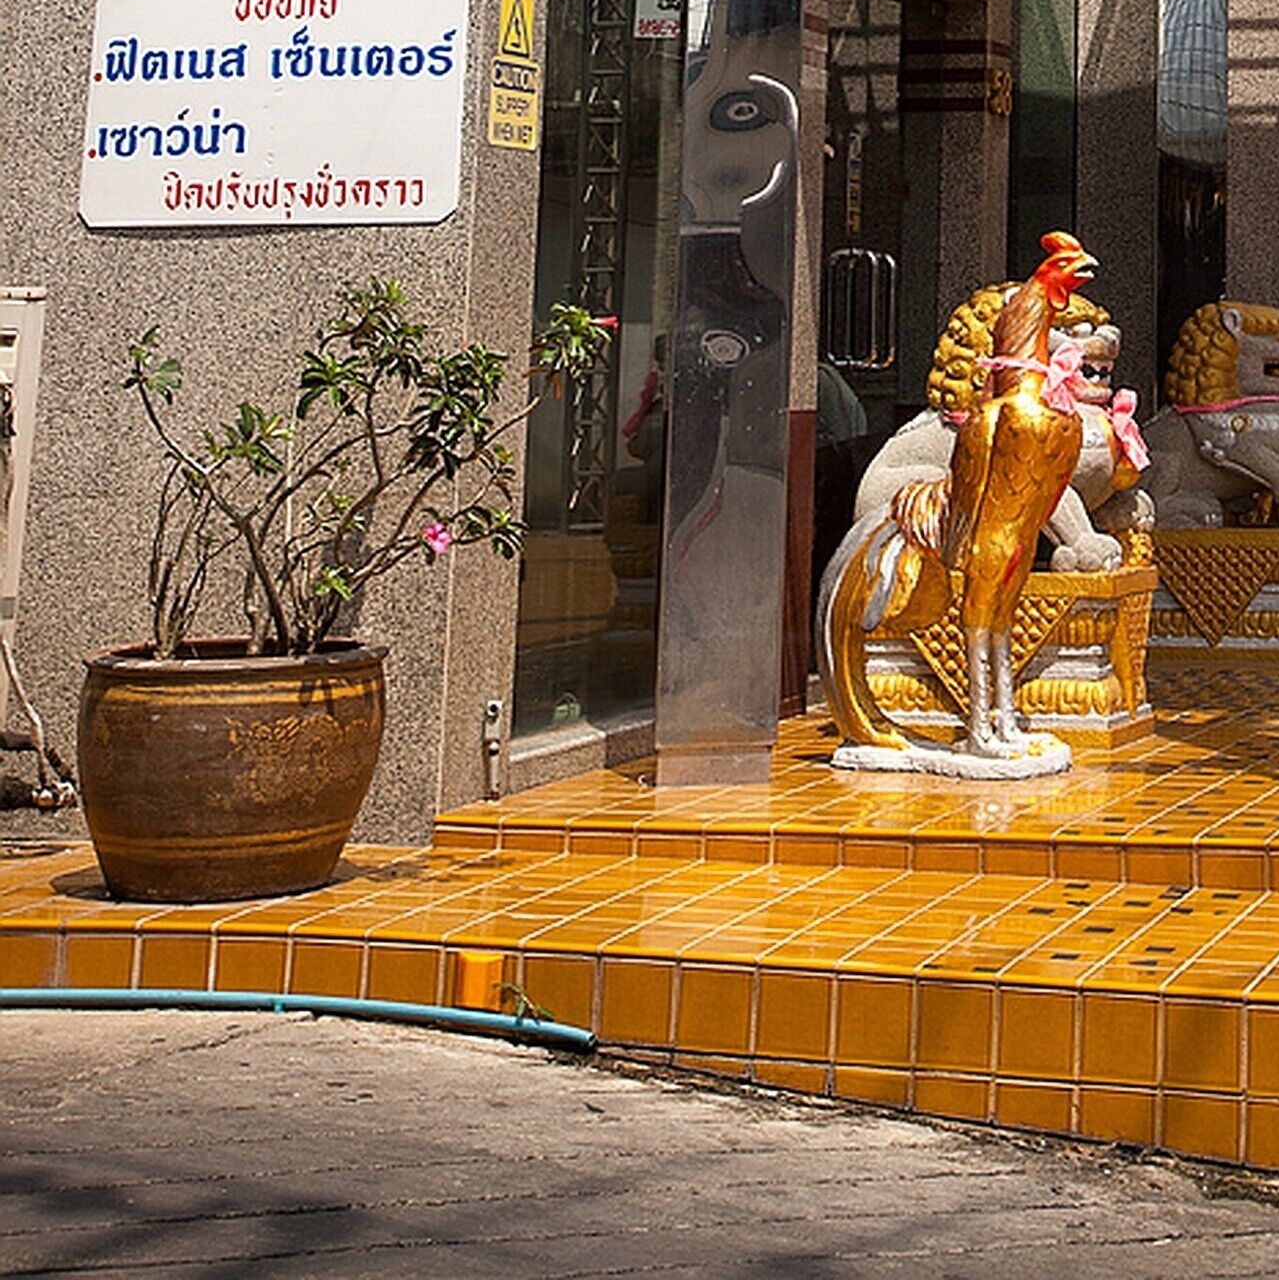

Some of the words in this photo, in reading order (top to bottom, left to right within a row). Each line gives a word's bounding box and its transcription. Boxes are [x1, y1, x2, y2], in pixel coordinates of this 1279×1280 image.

[271, 25, 457, 80] เซ็นเตอร์
[163, 164, 425, 219] ปิดปรับปรุงชั่วคราว
